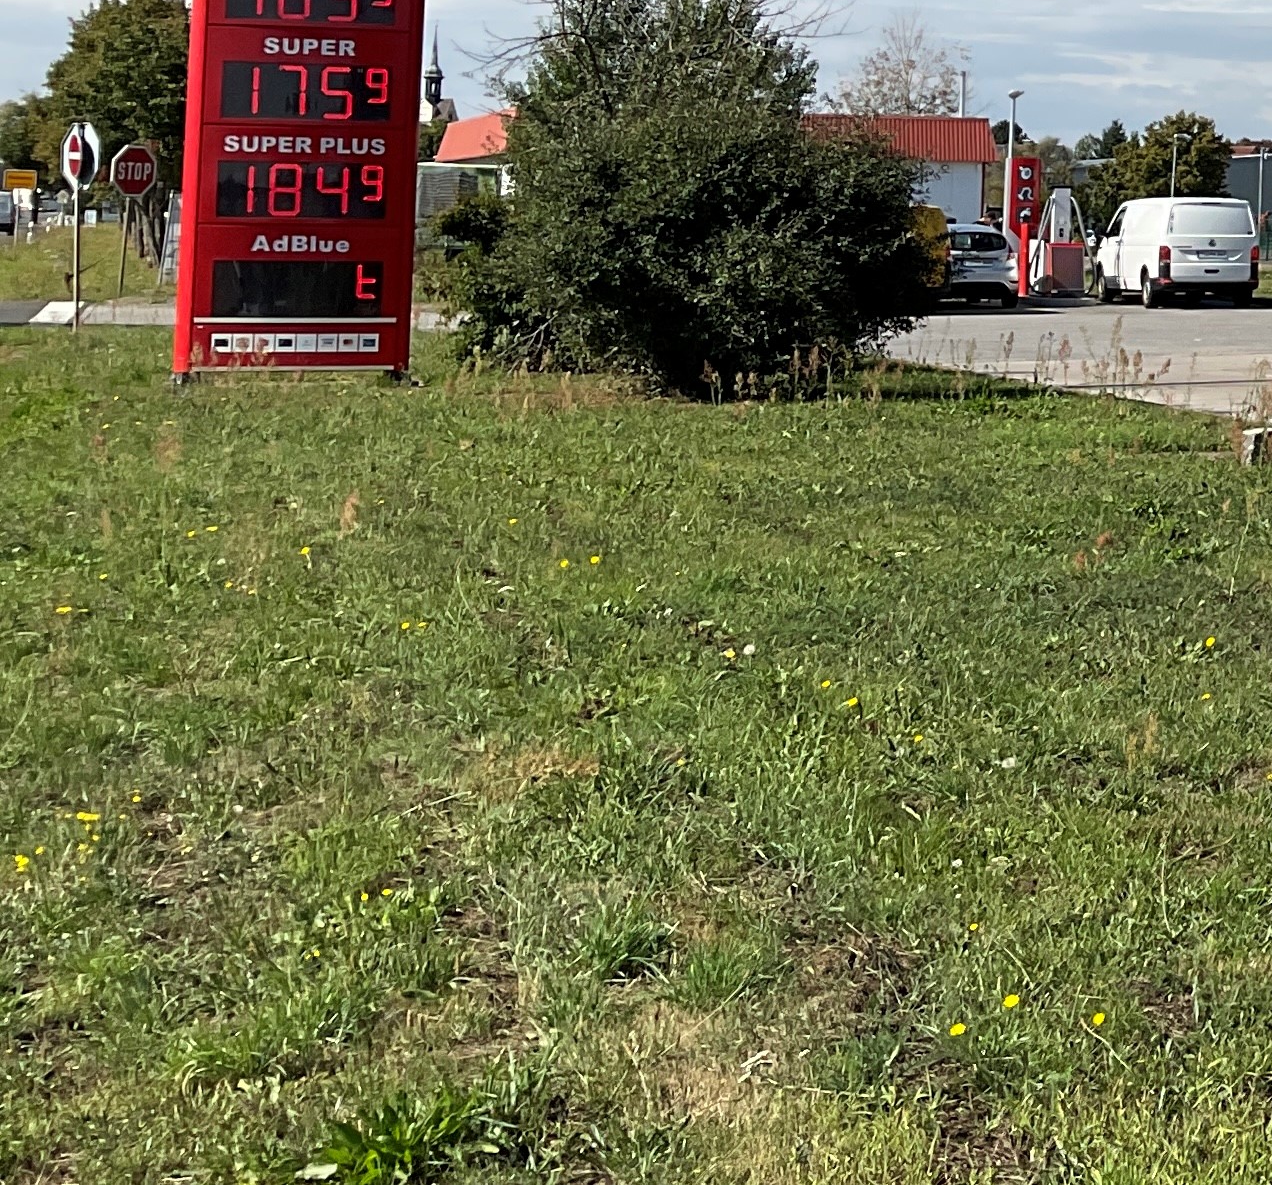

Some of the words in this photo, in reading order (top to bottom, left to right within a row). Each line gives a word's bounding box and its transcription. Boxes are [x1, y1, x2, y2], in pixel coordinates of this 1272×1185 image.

[263, 37, 355, 57] SUPER
[223, 135, 311, 154] SUPER
[320, 137, 386, 156] PLUS
[117, 161, 152, 181] STOP
[251, 234, 350, 254] AdBlue
